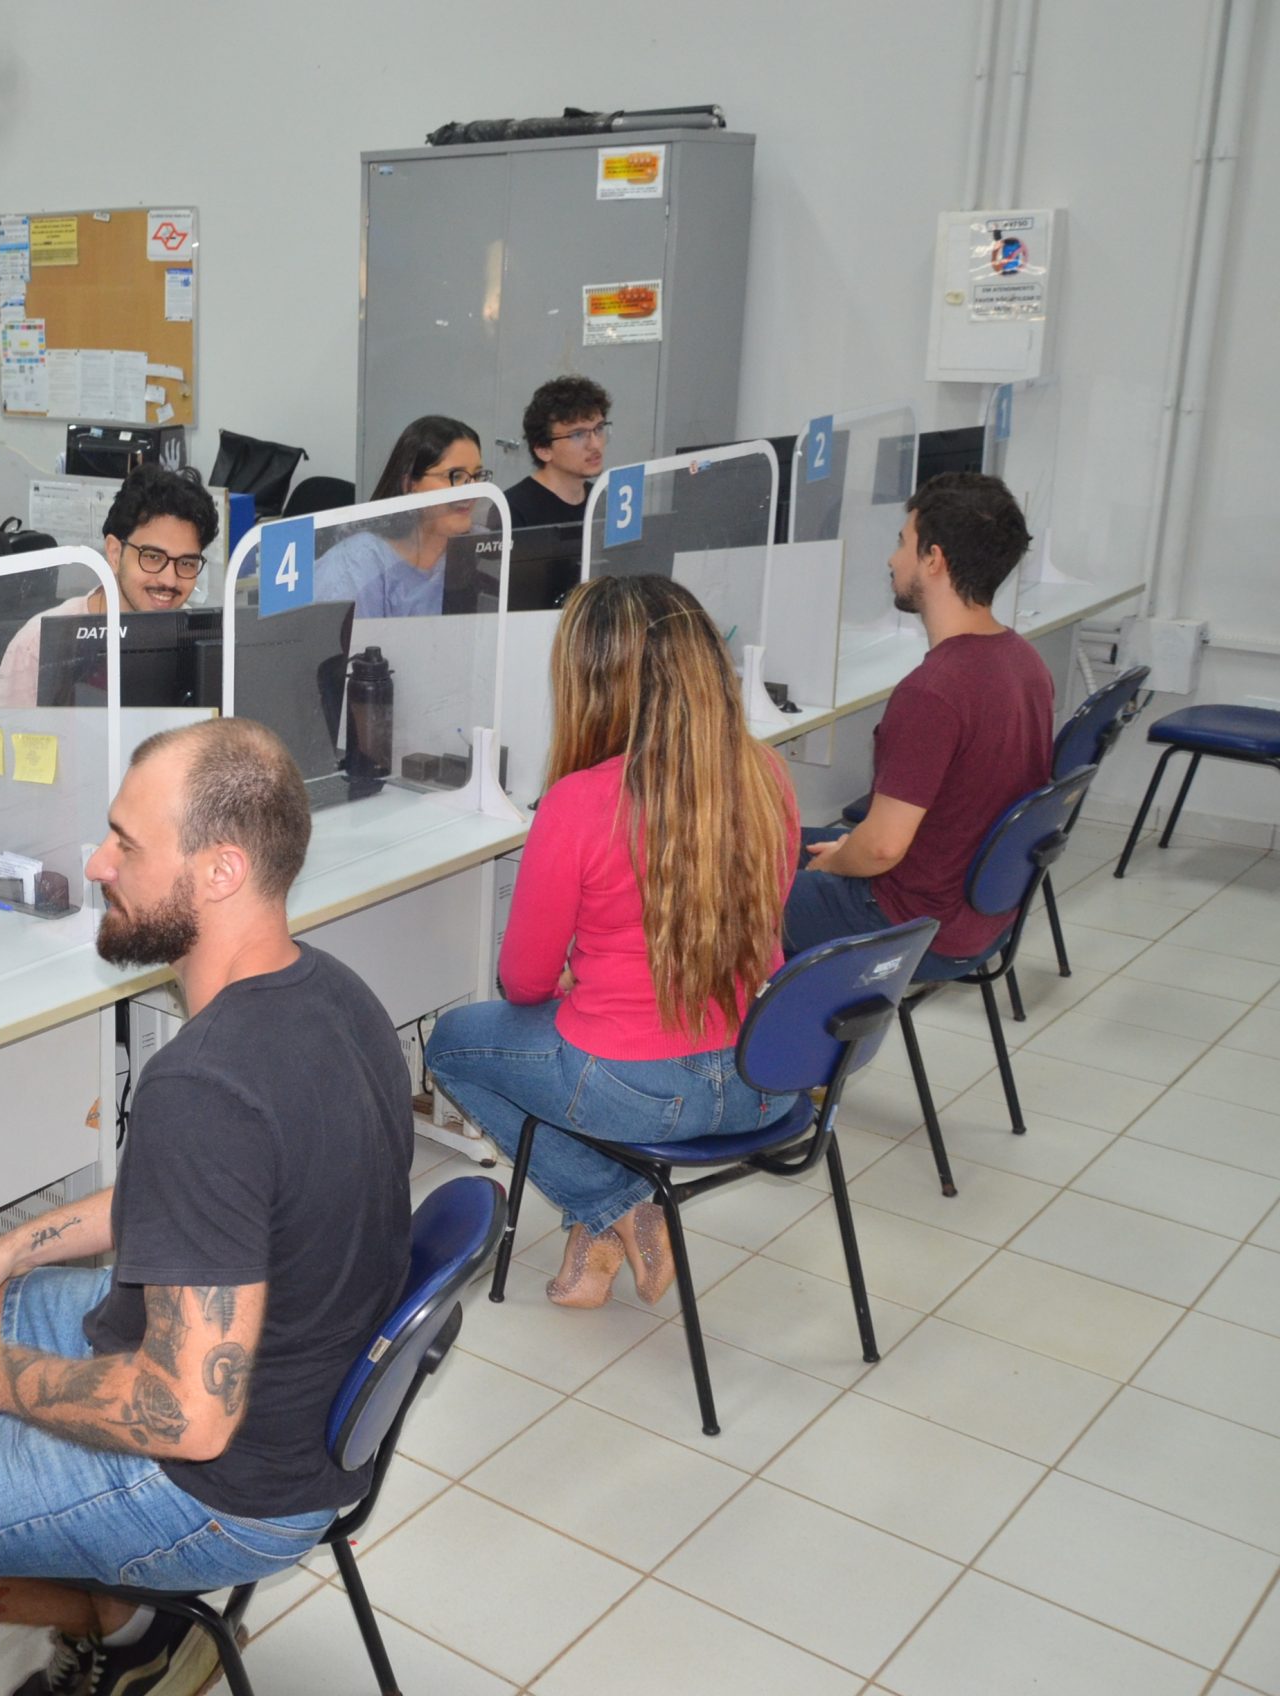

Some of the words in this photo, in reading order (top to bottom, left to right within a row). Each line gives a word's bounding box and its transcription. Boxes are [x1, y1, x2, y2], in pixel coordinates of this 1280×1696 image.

[813, 432, 825, 467] 2
[616, 485, 632, 528] 3
[275, 541, 298, 592] 4
[76, 626, 127, 640] DATN
